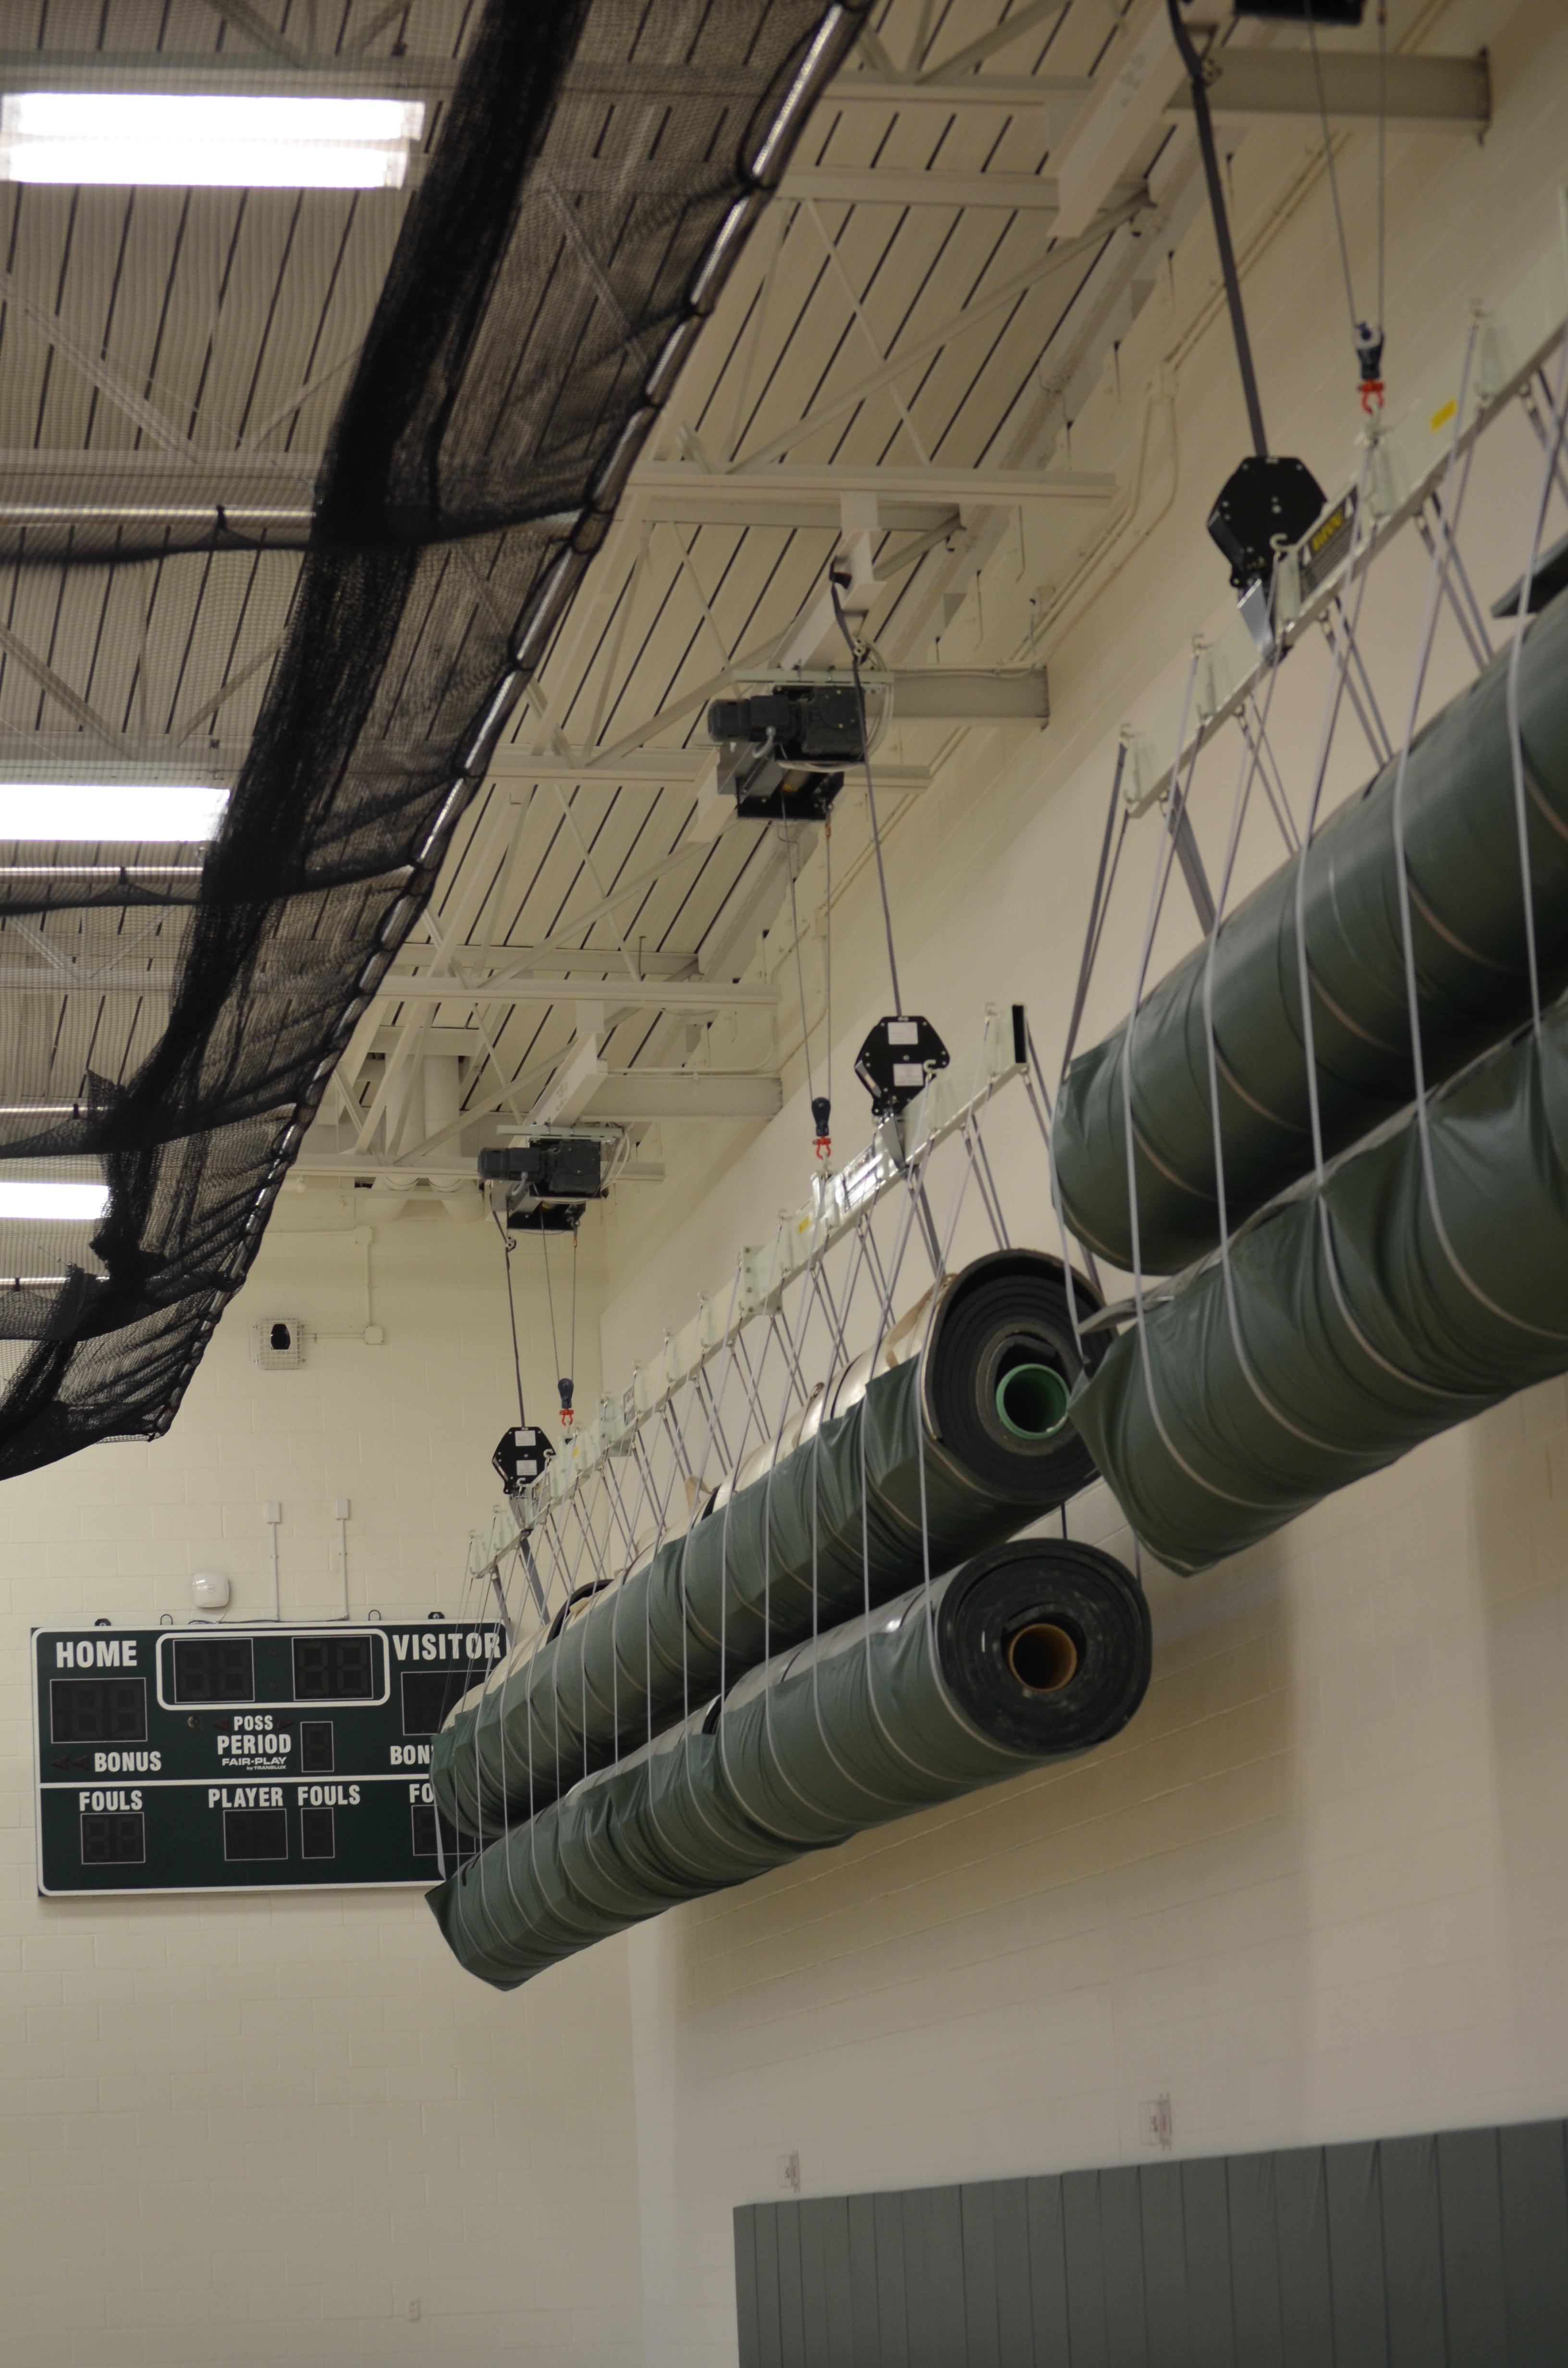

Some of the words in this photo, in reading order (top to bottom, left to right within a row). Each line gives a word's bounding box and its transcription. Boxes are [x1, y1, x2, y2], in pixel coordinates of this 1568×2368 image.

[56, 1640, 137, 1668] HOME
[392, 1633, 501, 1661] VISITOR
[233, 1715, 273, 1731] POSS
[217, 1734, 291, 1755] PERIOD
[390, 1745, 432, 1765] BON
[94, 1751, 161, 1772] BONUS
[222, 1757, 287, 1766] FAIR-PLAY
[79, 1790, 143, 1812] FOULS
[208, 1787, 283, 1808] PLAYER
[297, 1785, 360, 1806] FOULS
